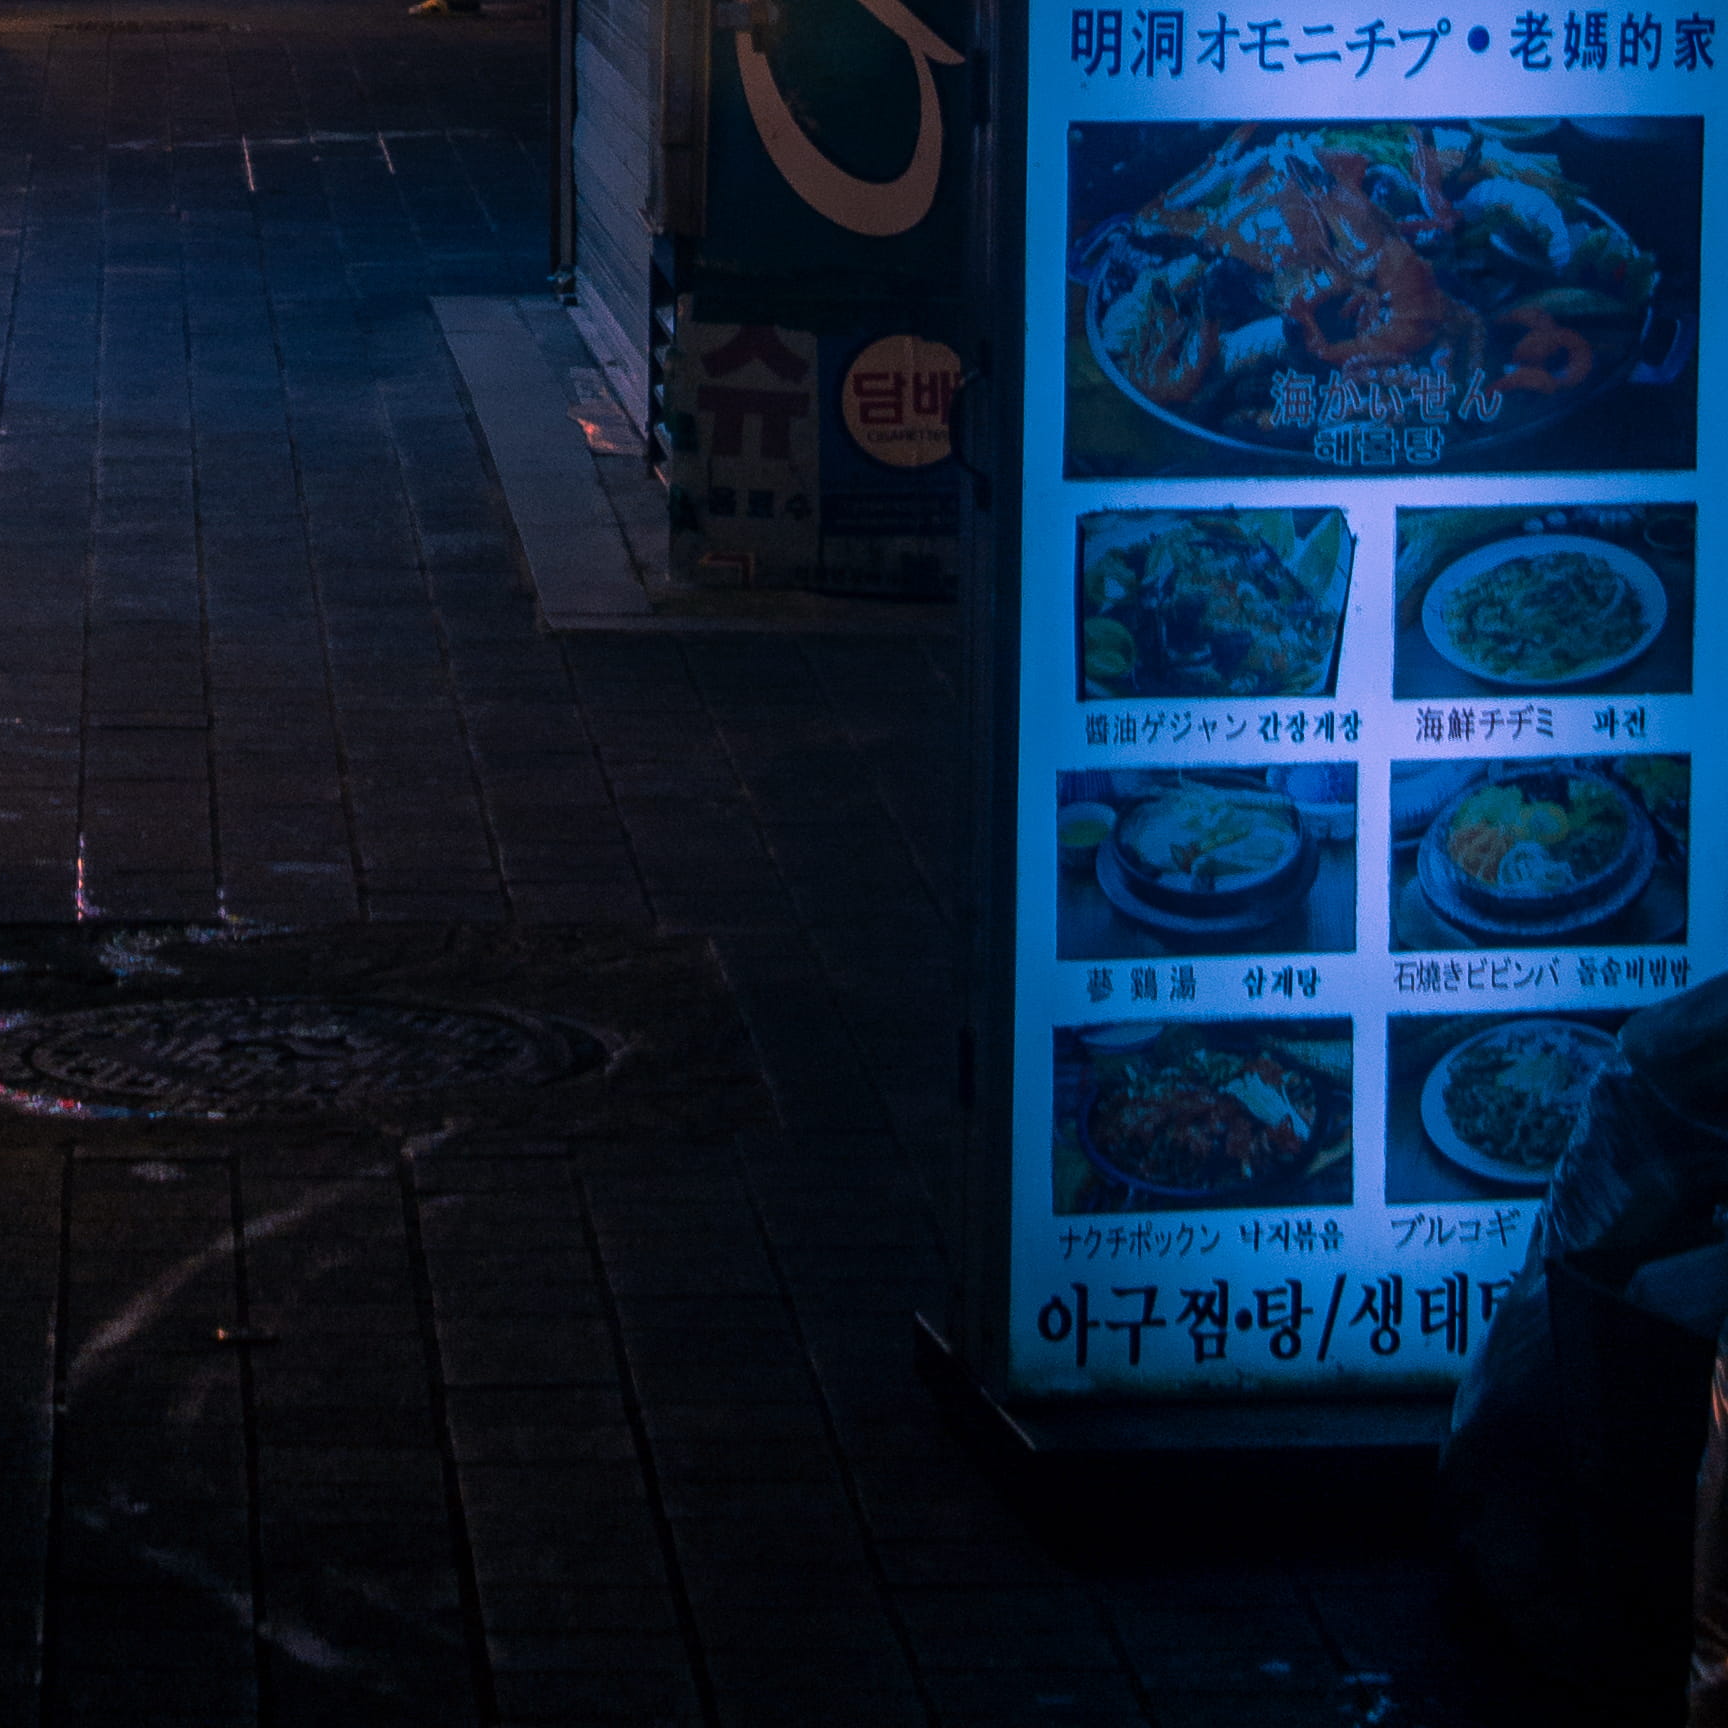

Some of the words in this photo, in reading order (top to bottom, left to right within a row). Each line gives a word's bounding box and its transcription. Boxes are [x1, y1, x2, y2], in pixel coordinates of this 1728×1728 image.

[853, 370, 964, 426] 담배
[1257, 709, 1363, 743] 간장게장
[1592, 706, 1650, 740] 파전
[1242, 964, 1322, 1000] 삼계탕
